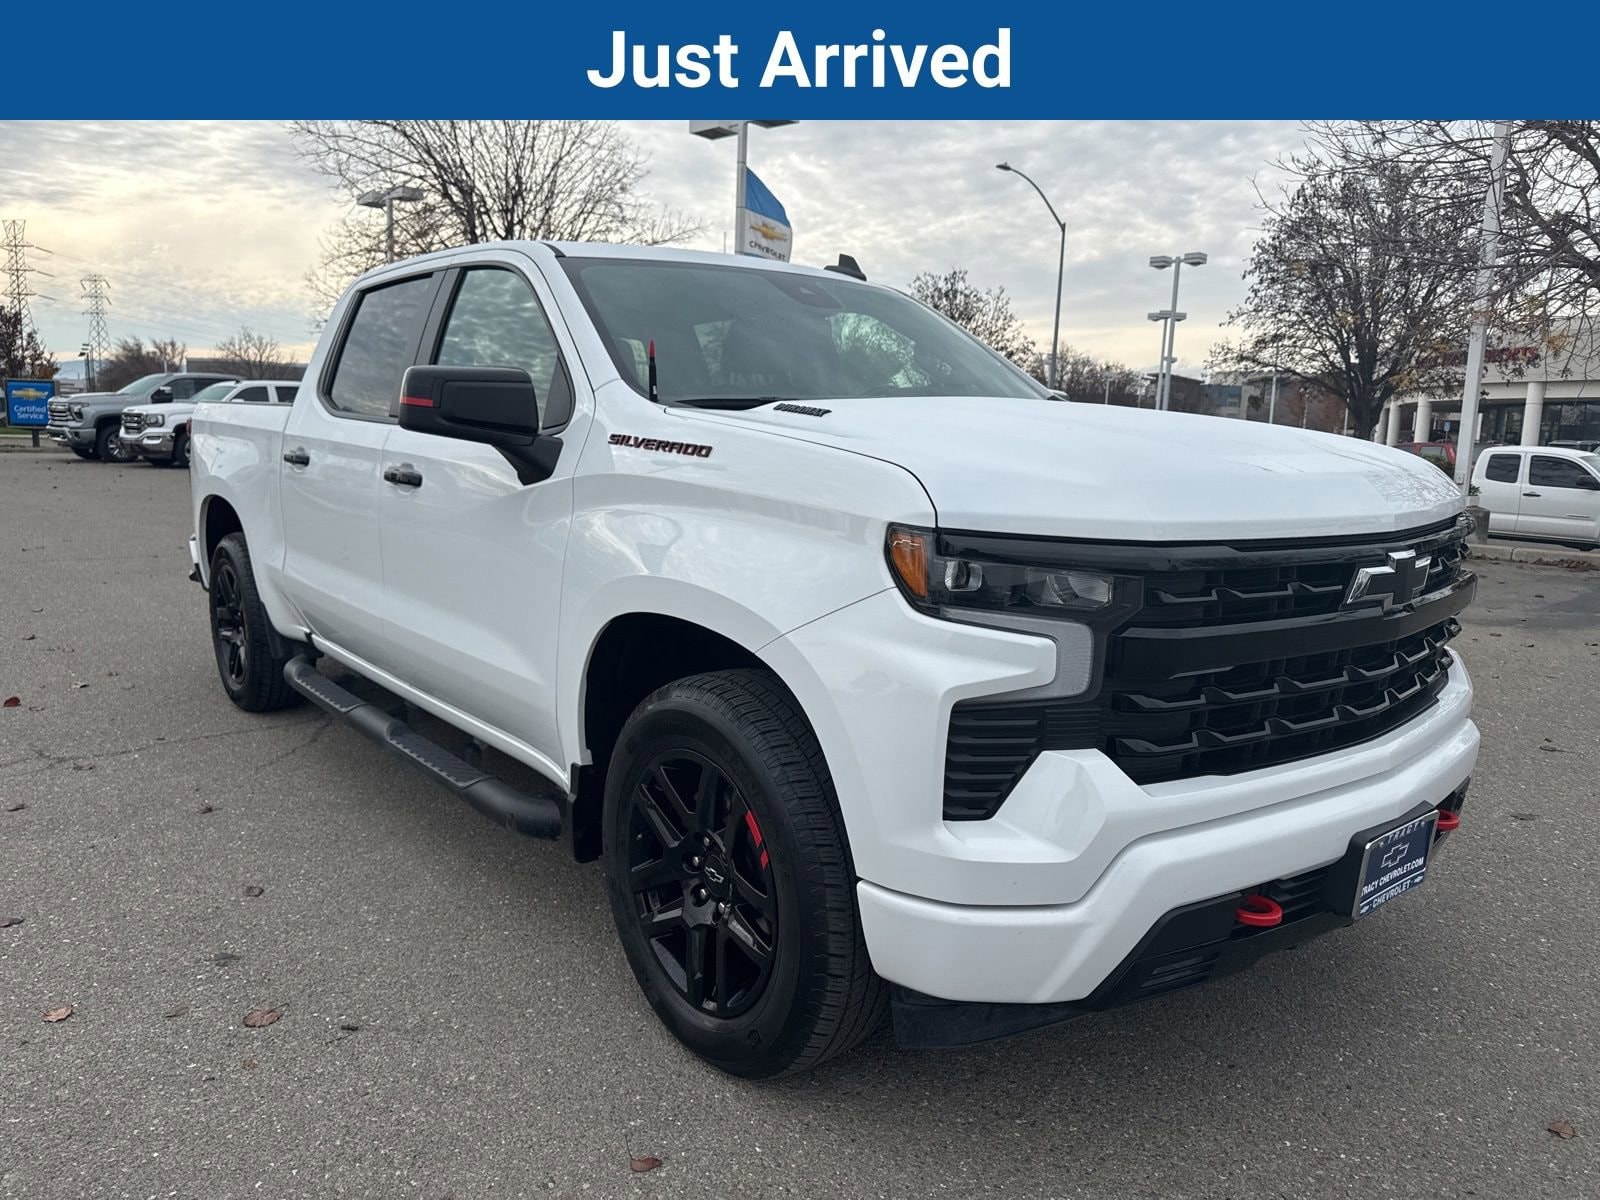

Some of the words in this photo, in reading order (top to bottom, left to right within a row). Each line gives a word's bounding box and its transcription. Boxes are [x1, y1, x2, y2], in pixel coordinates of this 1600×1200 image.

[14, 404, 47, 413] Certified
[17, 412, 44, 420] Service
[773, 402, 832, 418] DURAMAX
[608, 433, 713, 458] SILVERADO
[1387, 821, 1419, 843] TRACY
[1379, 856, 1424, 887] CHEVROLET.COM
[1372, 880, 1411, 908] CHEVROLET
